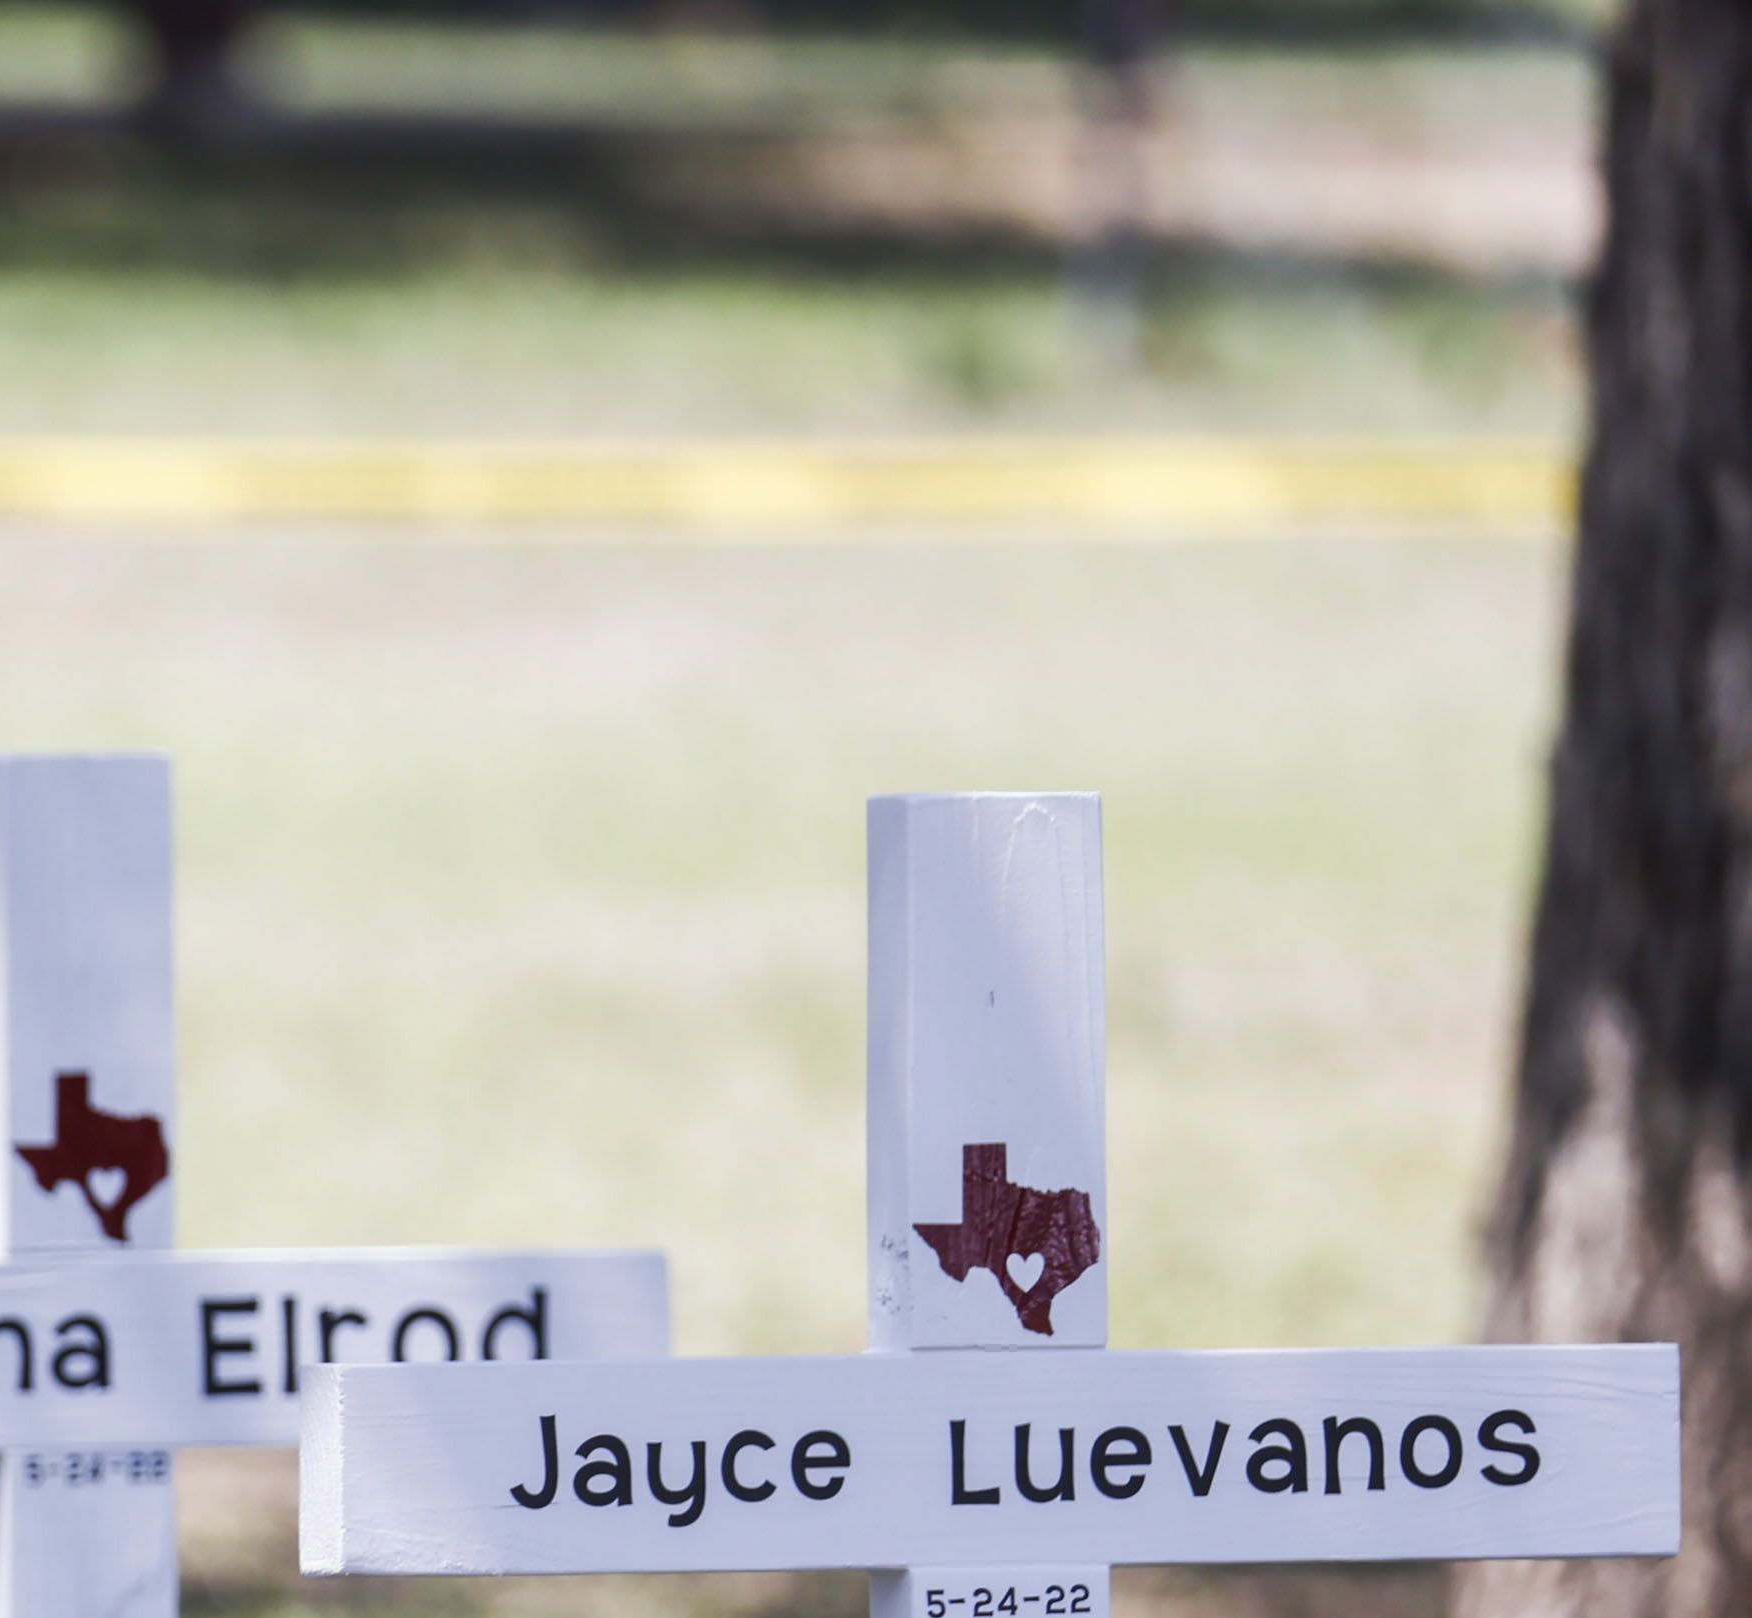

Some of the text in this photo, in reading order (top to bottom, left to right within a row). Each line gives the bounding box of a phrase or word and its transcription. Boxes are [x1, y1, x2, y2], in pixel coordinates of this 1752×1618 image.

[198, 1285, 549, 1399] Elrod
[510, 1409, 1540, 1528] Jayce Luevanos
[926, 1583, 1091, 1618] 5-24-22
